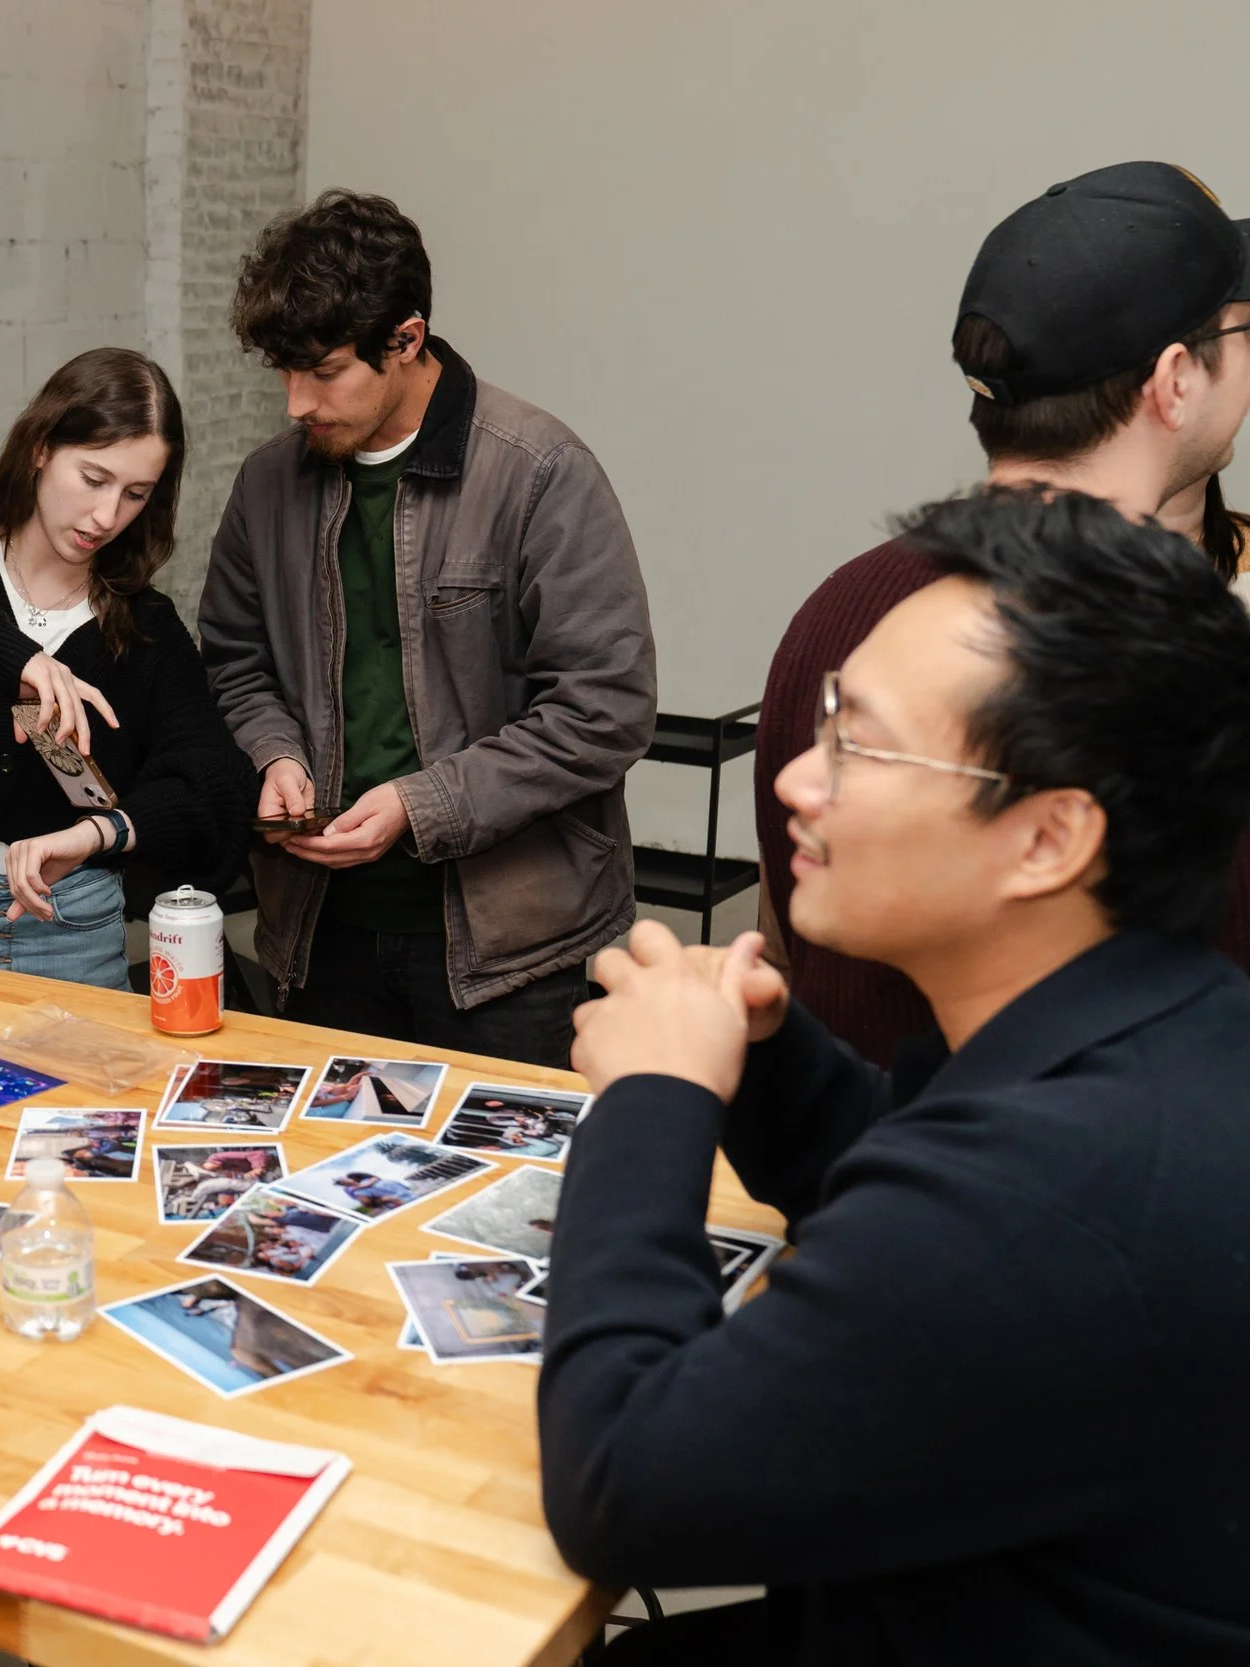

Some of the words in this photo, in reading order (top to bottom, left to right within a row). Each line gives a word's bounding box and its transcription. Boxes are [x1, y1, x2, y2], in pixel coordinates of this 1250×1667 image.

[38, 1497, 57, 1511] a
[52, 1483, 172, 1513] moment
[171, 1498, 231, 1527] into
[70, 1464, 130, 1486] Turn
[131, 1474, 215, 1506] every
